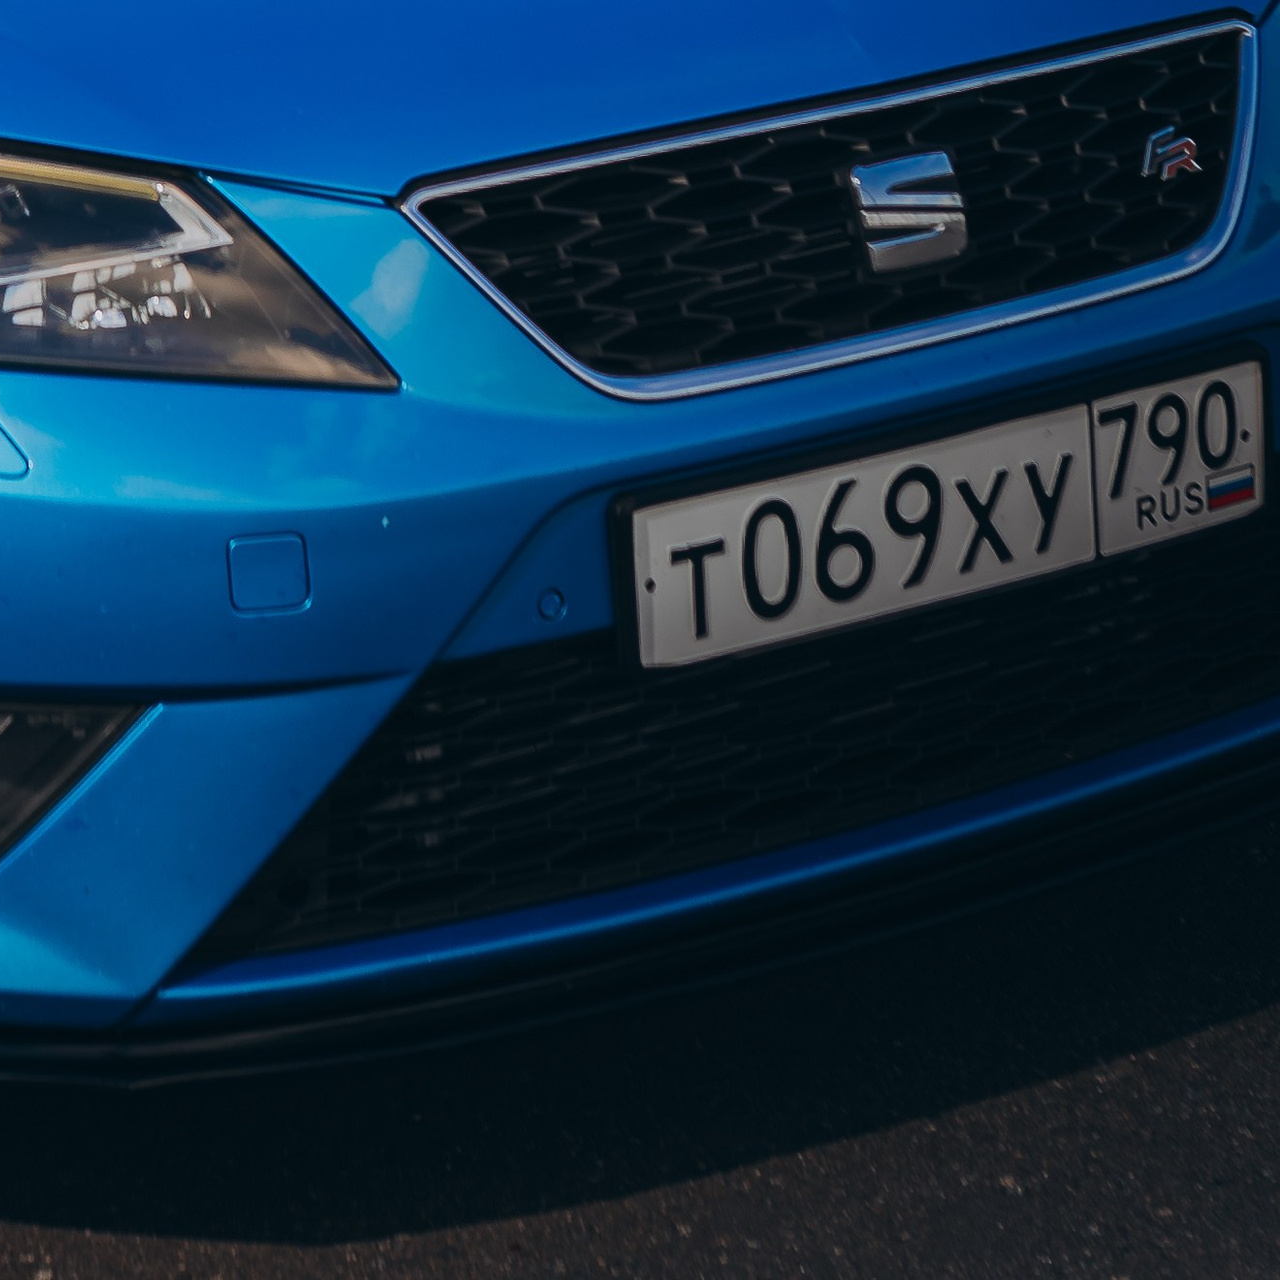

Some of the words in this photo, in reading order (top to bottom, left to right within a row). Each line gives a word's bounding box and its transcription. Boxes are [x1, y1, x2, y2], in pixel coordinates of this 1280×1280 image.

[1141, 125, 1203, 181] FR
[1097, 379, 1238, 500] 790
[1135, 480, 1205, 531] RUS
